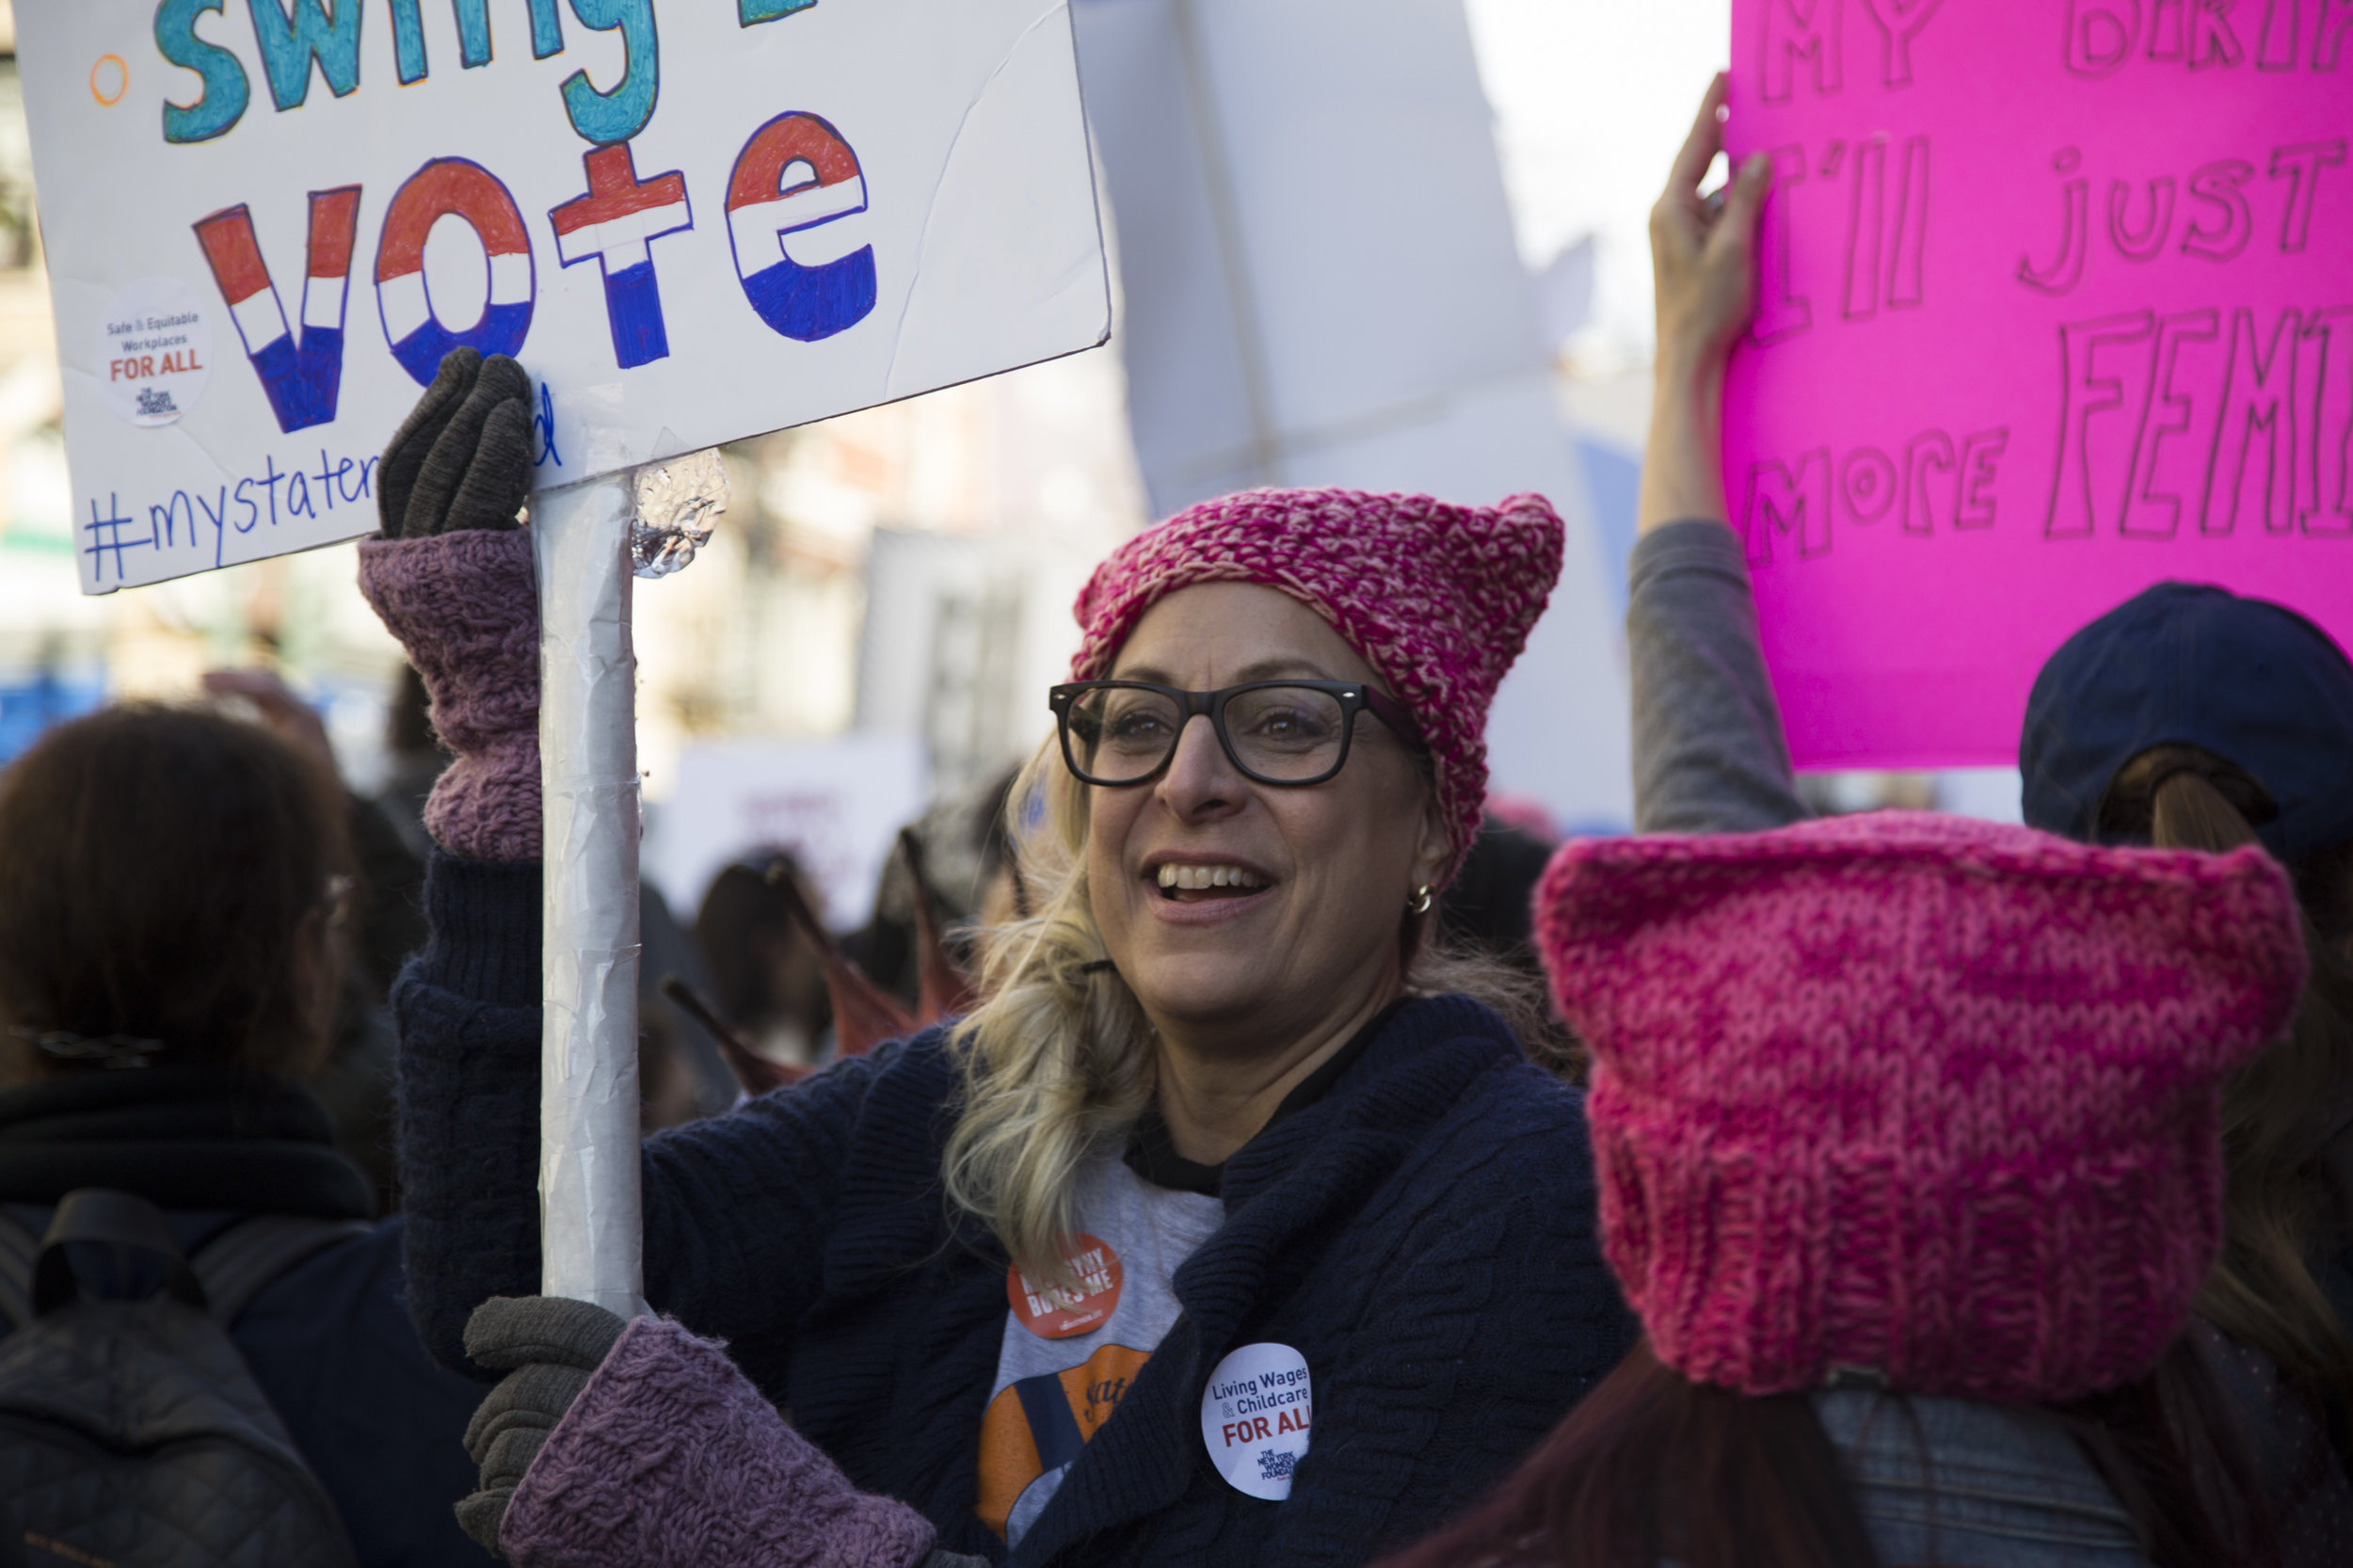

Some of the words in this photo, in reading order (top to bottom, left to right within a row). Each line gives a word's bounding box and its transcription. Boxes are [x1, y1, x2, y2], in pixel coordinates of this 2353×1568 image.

[1756, 0, 1944, 105] MY
[107, 322, 133, 336] Safe
[147, 312, 199, 331] Equitable
[121, 333, 187, 352] Workplaces
[110, 356, 155, 382] FOR
[159, 348, 203, 375] ALL
[1027, 1286, 1084, 1318] BOES
[1084, 1269, 1113, 1296] ME
[1211, 1380, 1257, 1400] Living
[1258, 1368, 1307, 1388] Wages
[1222, 1402, 1235, 1418] &
[1237, 1388, 1308, 1415] Childcare
[1222, 1416, 1273, 1448] FOR
